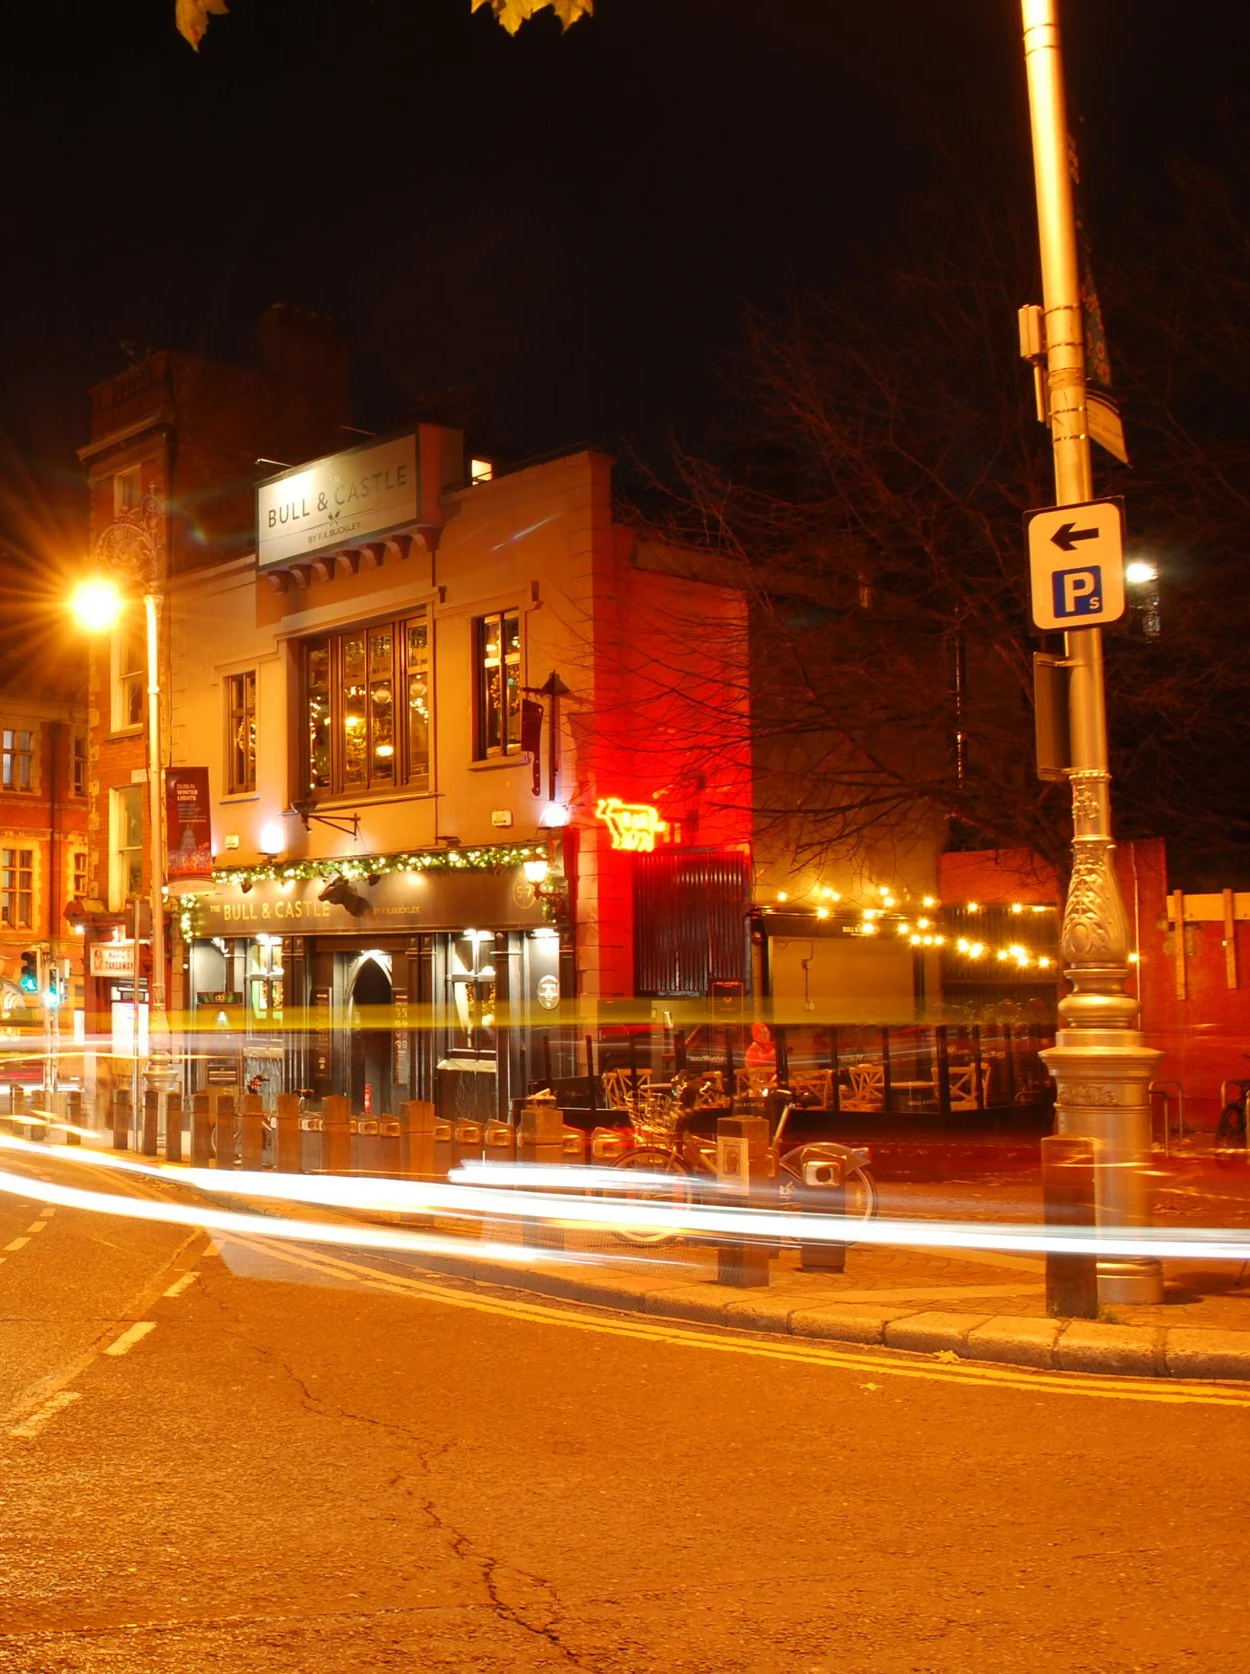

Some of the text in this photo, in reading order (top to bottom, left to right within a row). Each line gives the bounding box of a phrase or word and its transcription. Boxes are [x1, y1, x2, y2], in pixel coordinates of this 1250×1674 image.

[268, 465, 406, 528] BULL & CASTLE
[210, 900, 331, 920] THE BULL & CASTLE
